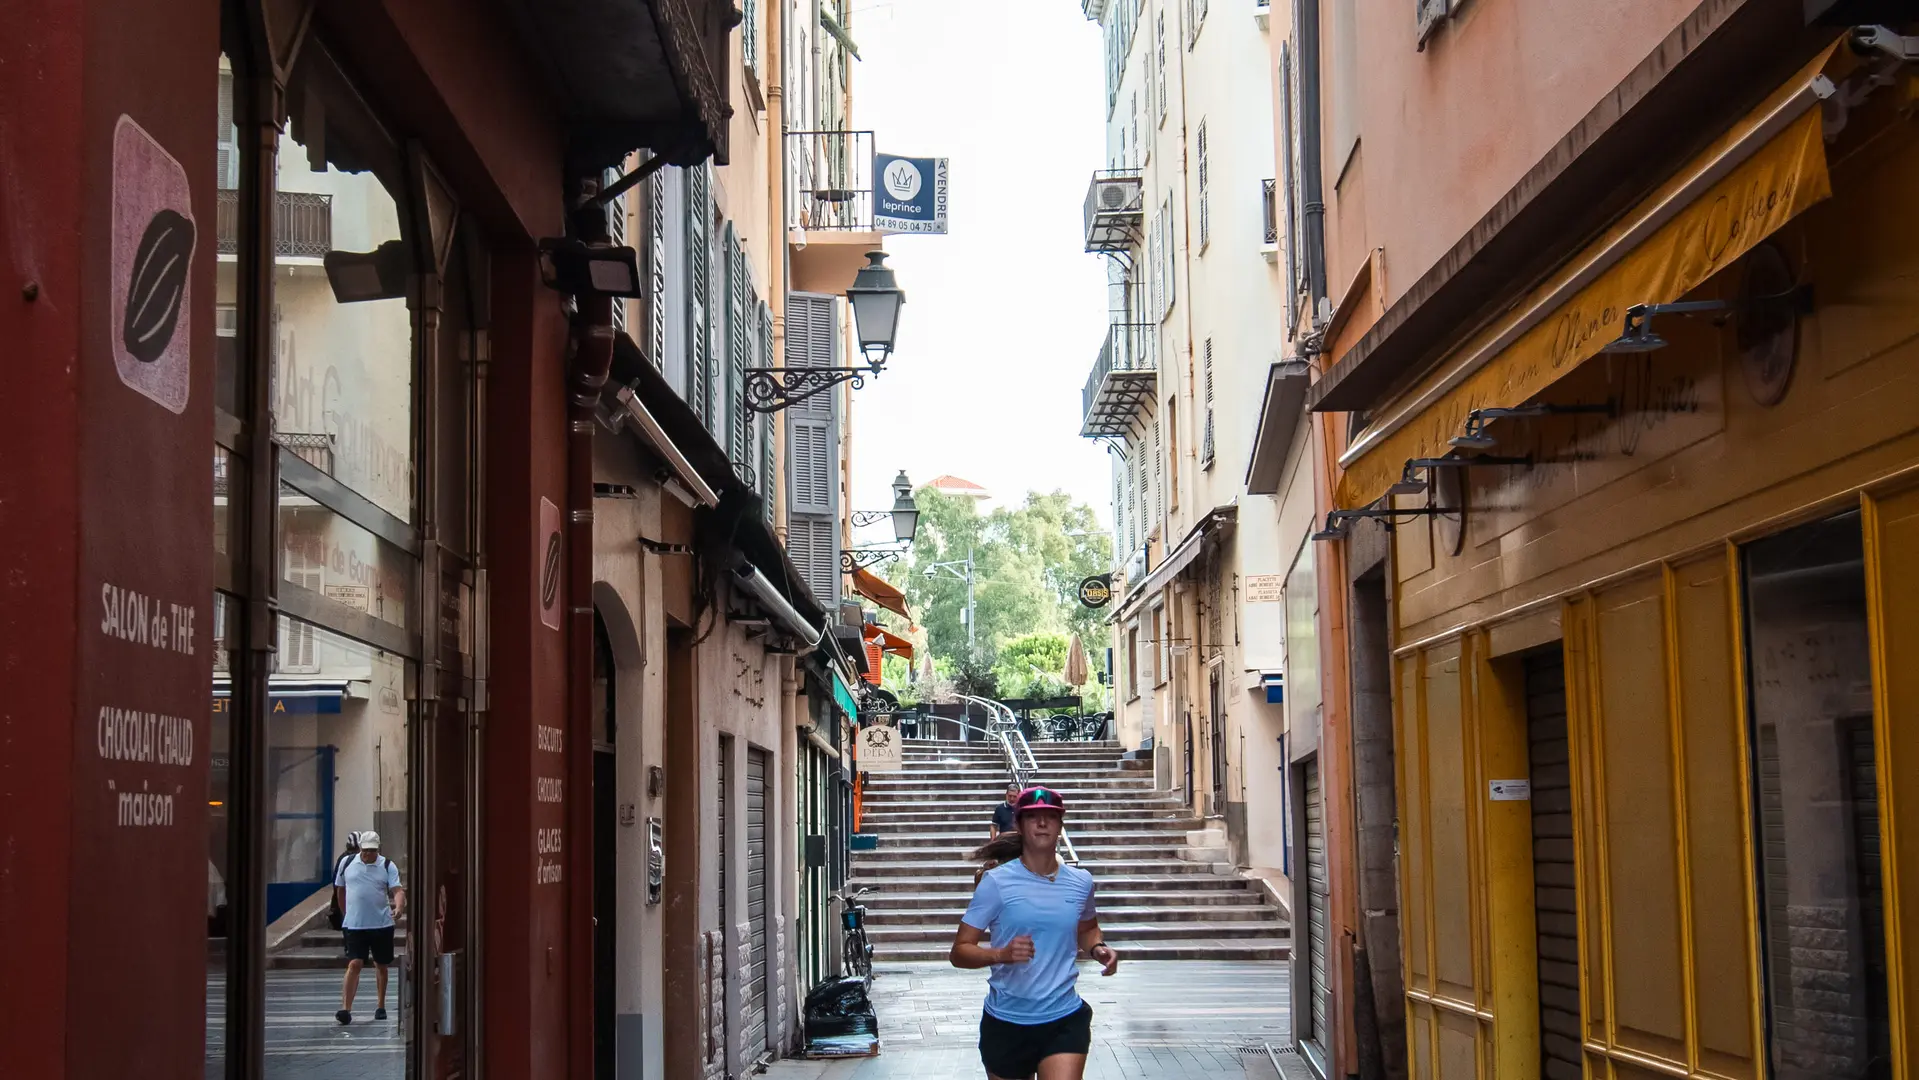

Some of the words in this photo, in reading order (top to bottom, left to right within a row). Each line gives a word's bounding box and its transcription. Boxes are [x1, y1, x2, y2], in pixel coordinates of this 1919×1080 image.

[882, 198, 922, 213] leprince
[937, 171, 947, 219] VENDRE
[875, 217, 886, 227] 04
[887, 219, 897, 229] 89
[898, 221, 908, 230] 05
[909, 222, 920, 231] 04
[922, 222, 932, 232] 75
[101, 582, 149, 645] SALON
[151, 599, 168, 649] de
[98, 705, 157, 763] CHOCOLAT
[158, 714, 193, 766] CHAUD
[538, 724, 563, 753] BISCUITS
[537, 776, 563, 802] CHOCOLATS
[537, 828, 562, 854] GLACES
